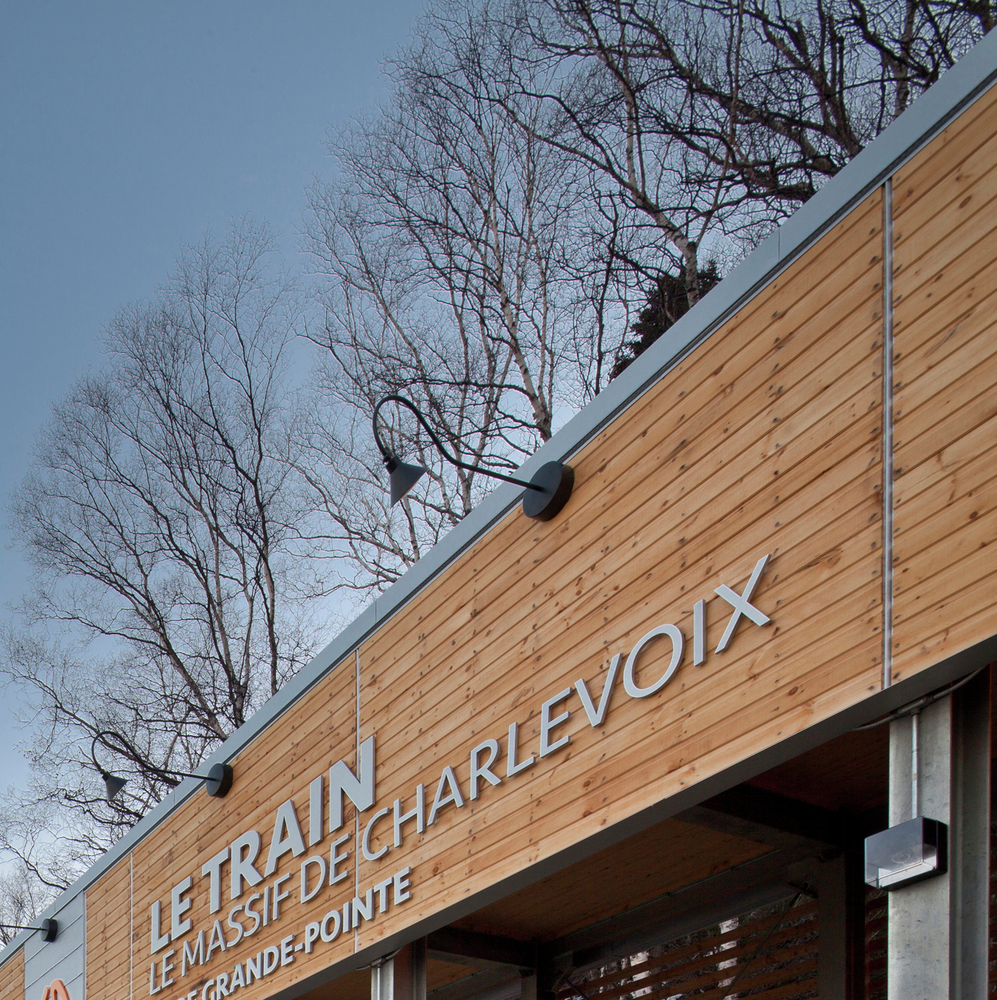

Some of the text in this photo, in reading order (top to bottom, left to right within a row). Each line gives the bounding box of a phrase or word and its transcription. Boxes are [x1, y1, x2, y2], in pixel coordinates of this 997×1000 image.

[149, 553, 771, 996] LE MASSIF DE CHARLEVOIX
[150, 735, 376, 954] LE TRAIN
